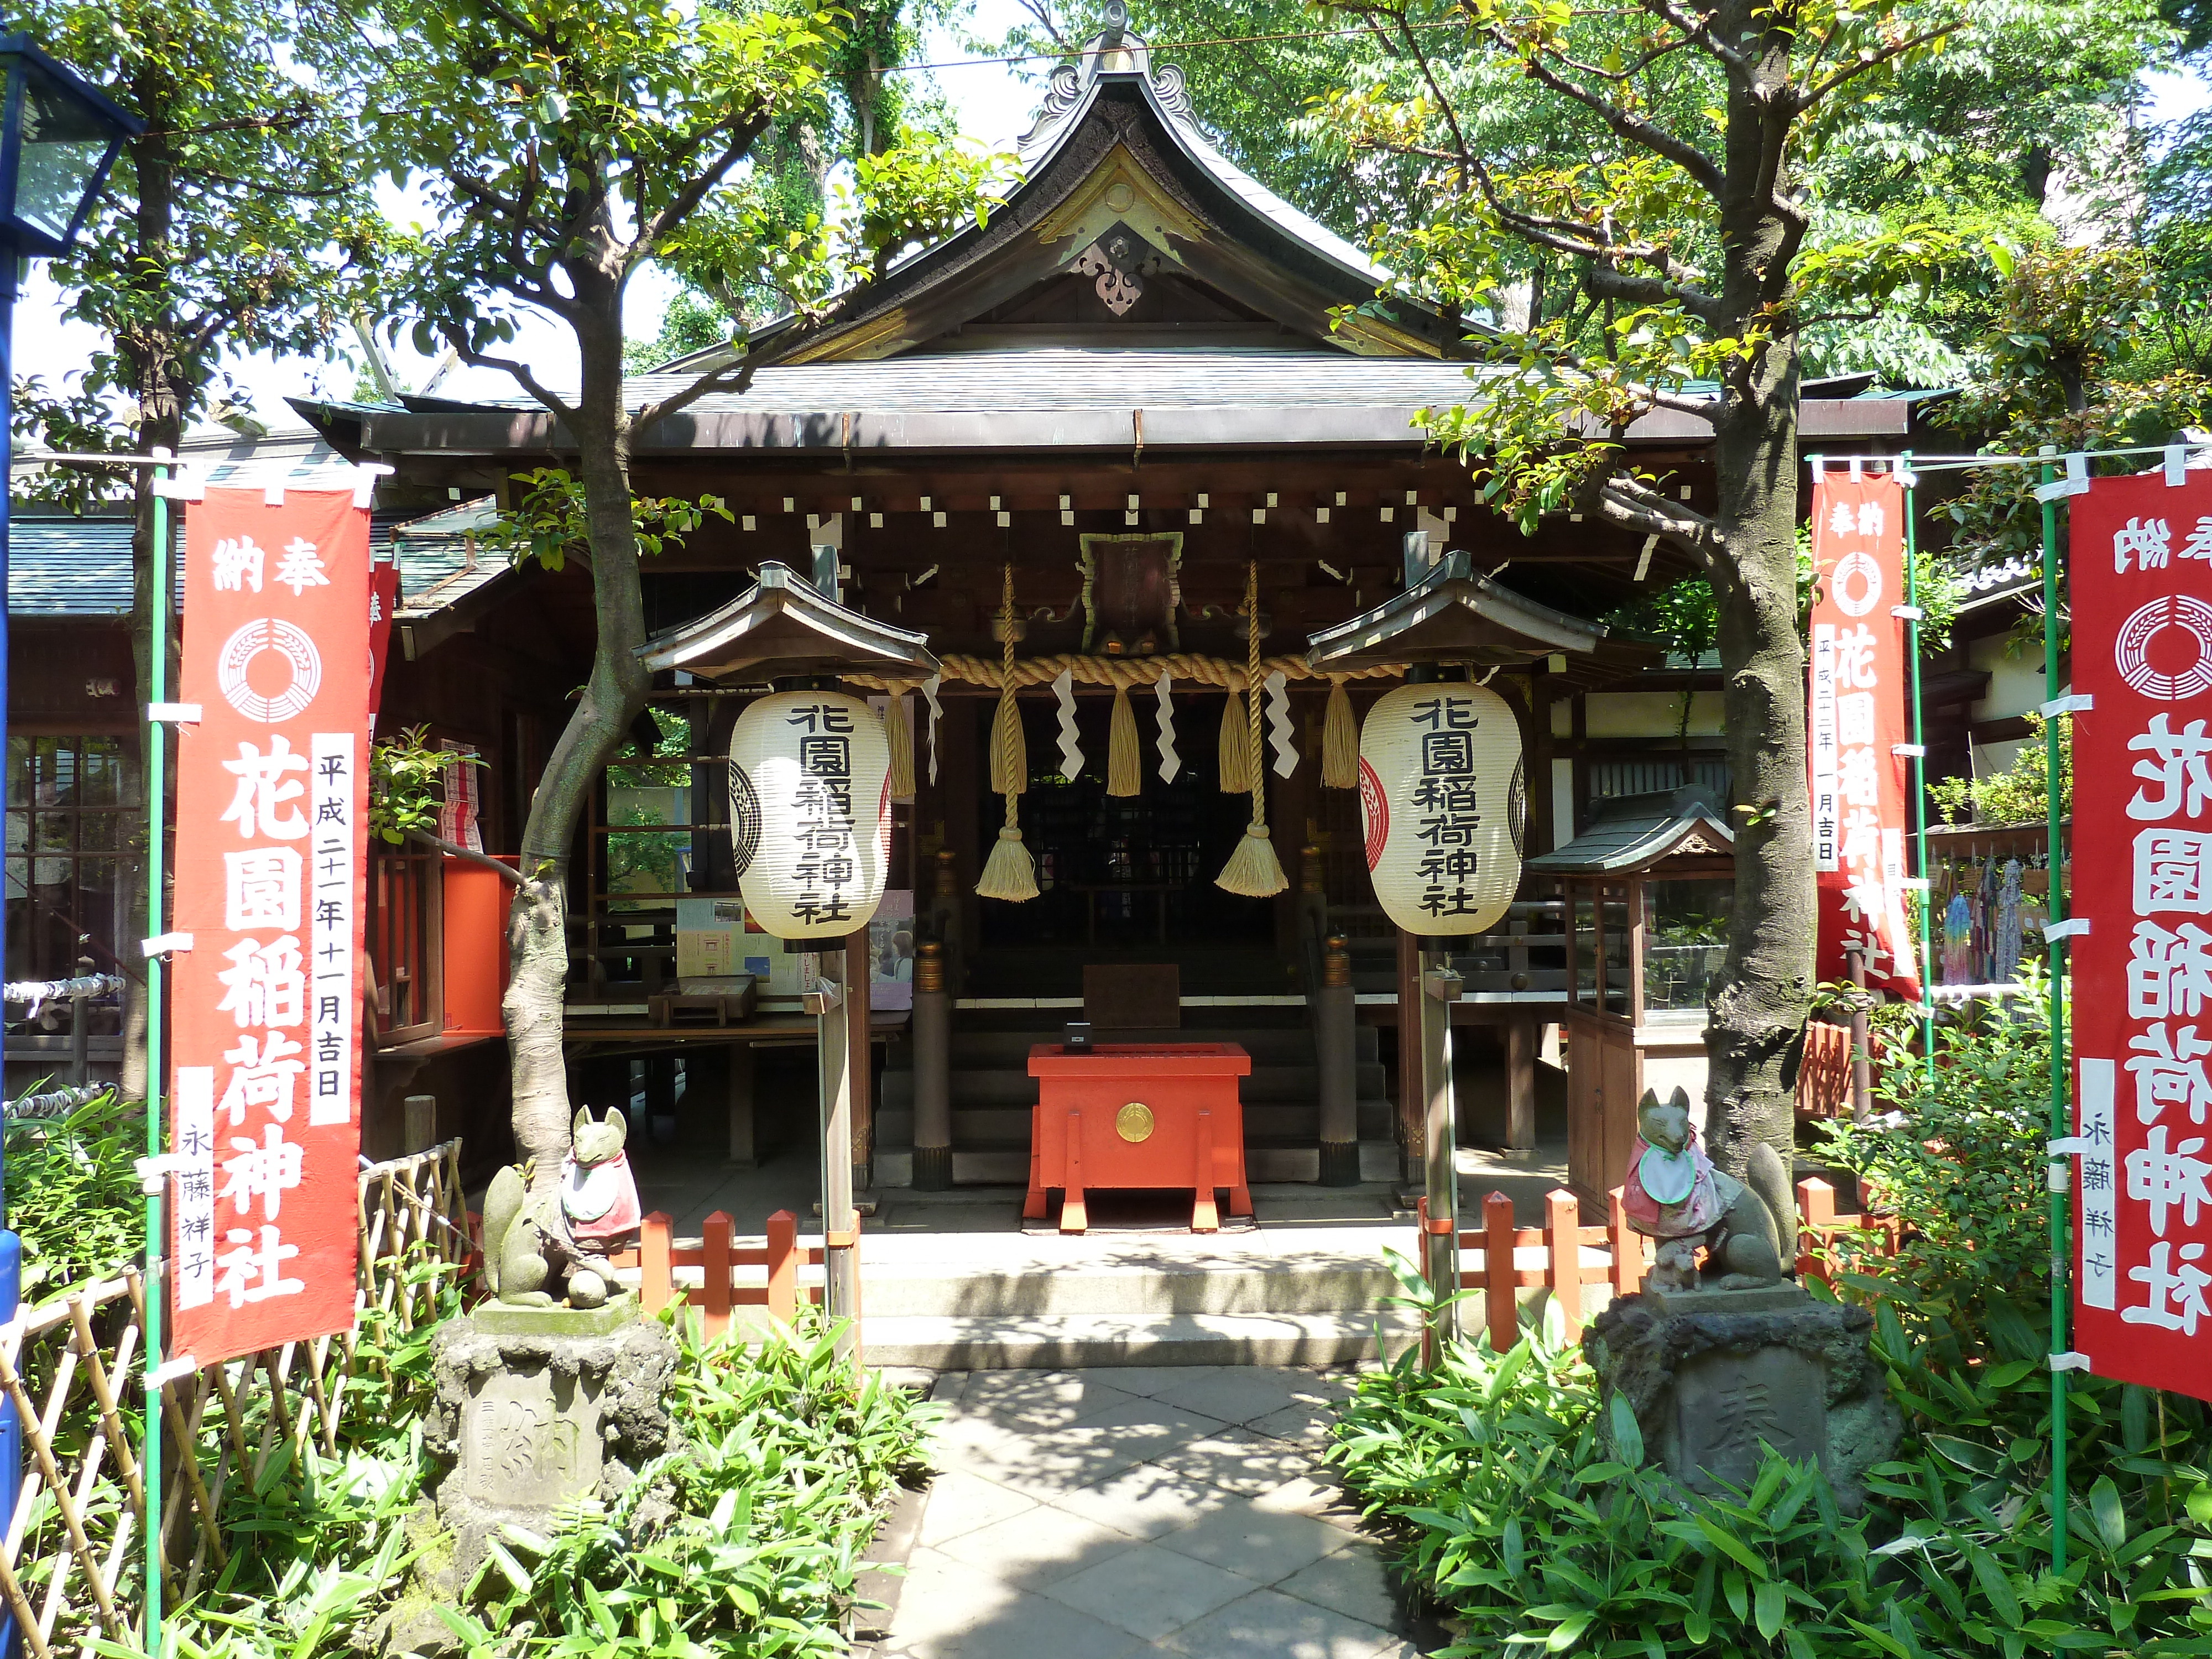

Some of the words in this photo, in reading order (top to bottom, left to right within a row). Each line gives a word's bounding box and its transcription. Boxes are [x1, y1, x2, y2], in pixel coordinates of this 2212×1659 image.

[785, 705, 855, 925] 花園稲荷神社
[1409, 698, 1480, 917] 花園稲荷神社
[1817, 640, 1835, 860] 平成二十二年一月吉日
[216, 734, 311, 1309] 花園稲荷神社
[315, 754, 347, 1097] 平成二十一年十一月吉日
[180, 1124, 213, 1279] 永藤祥子
